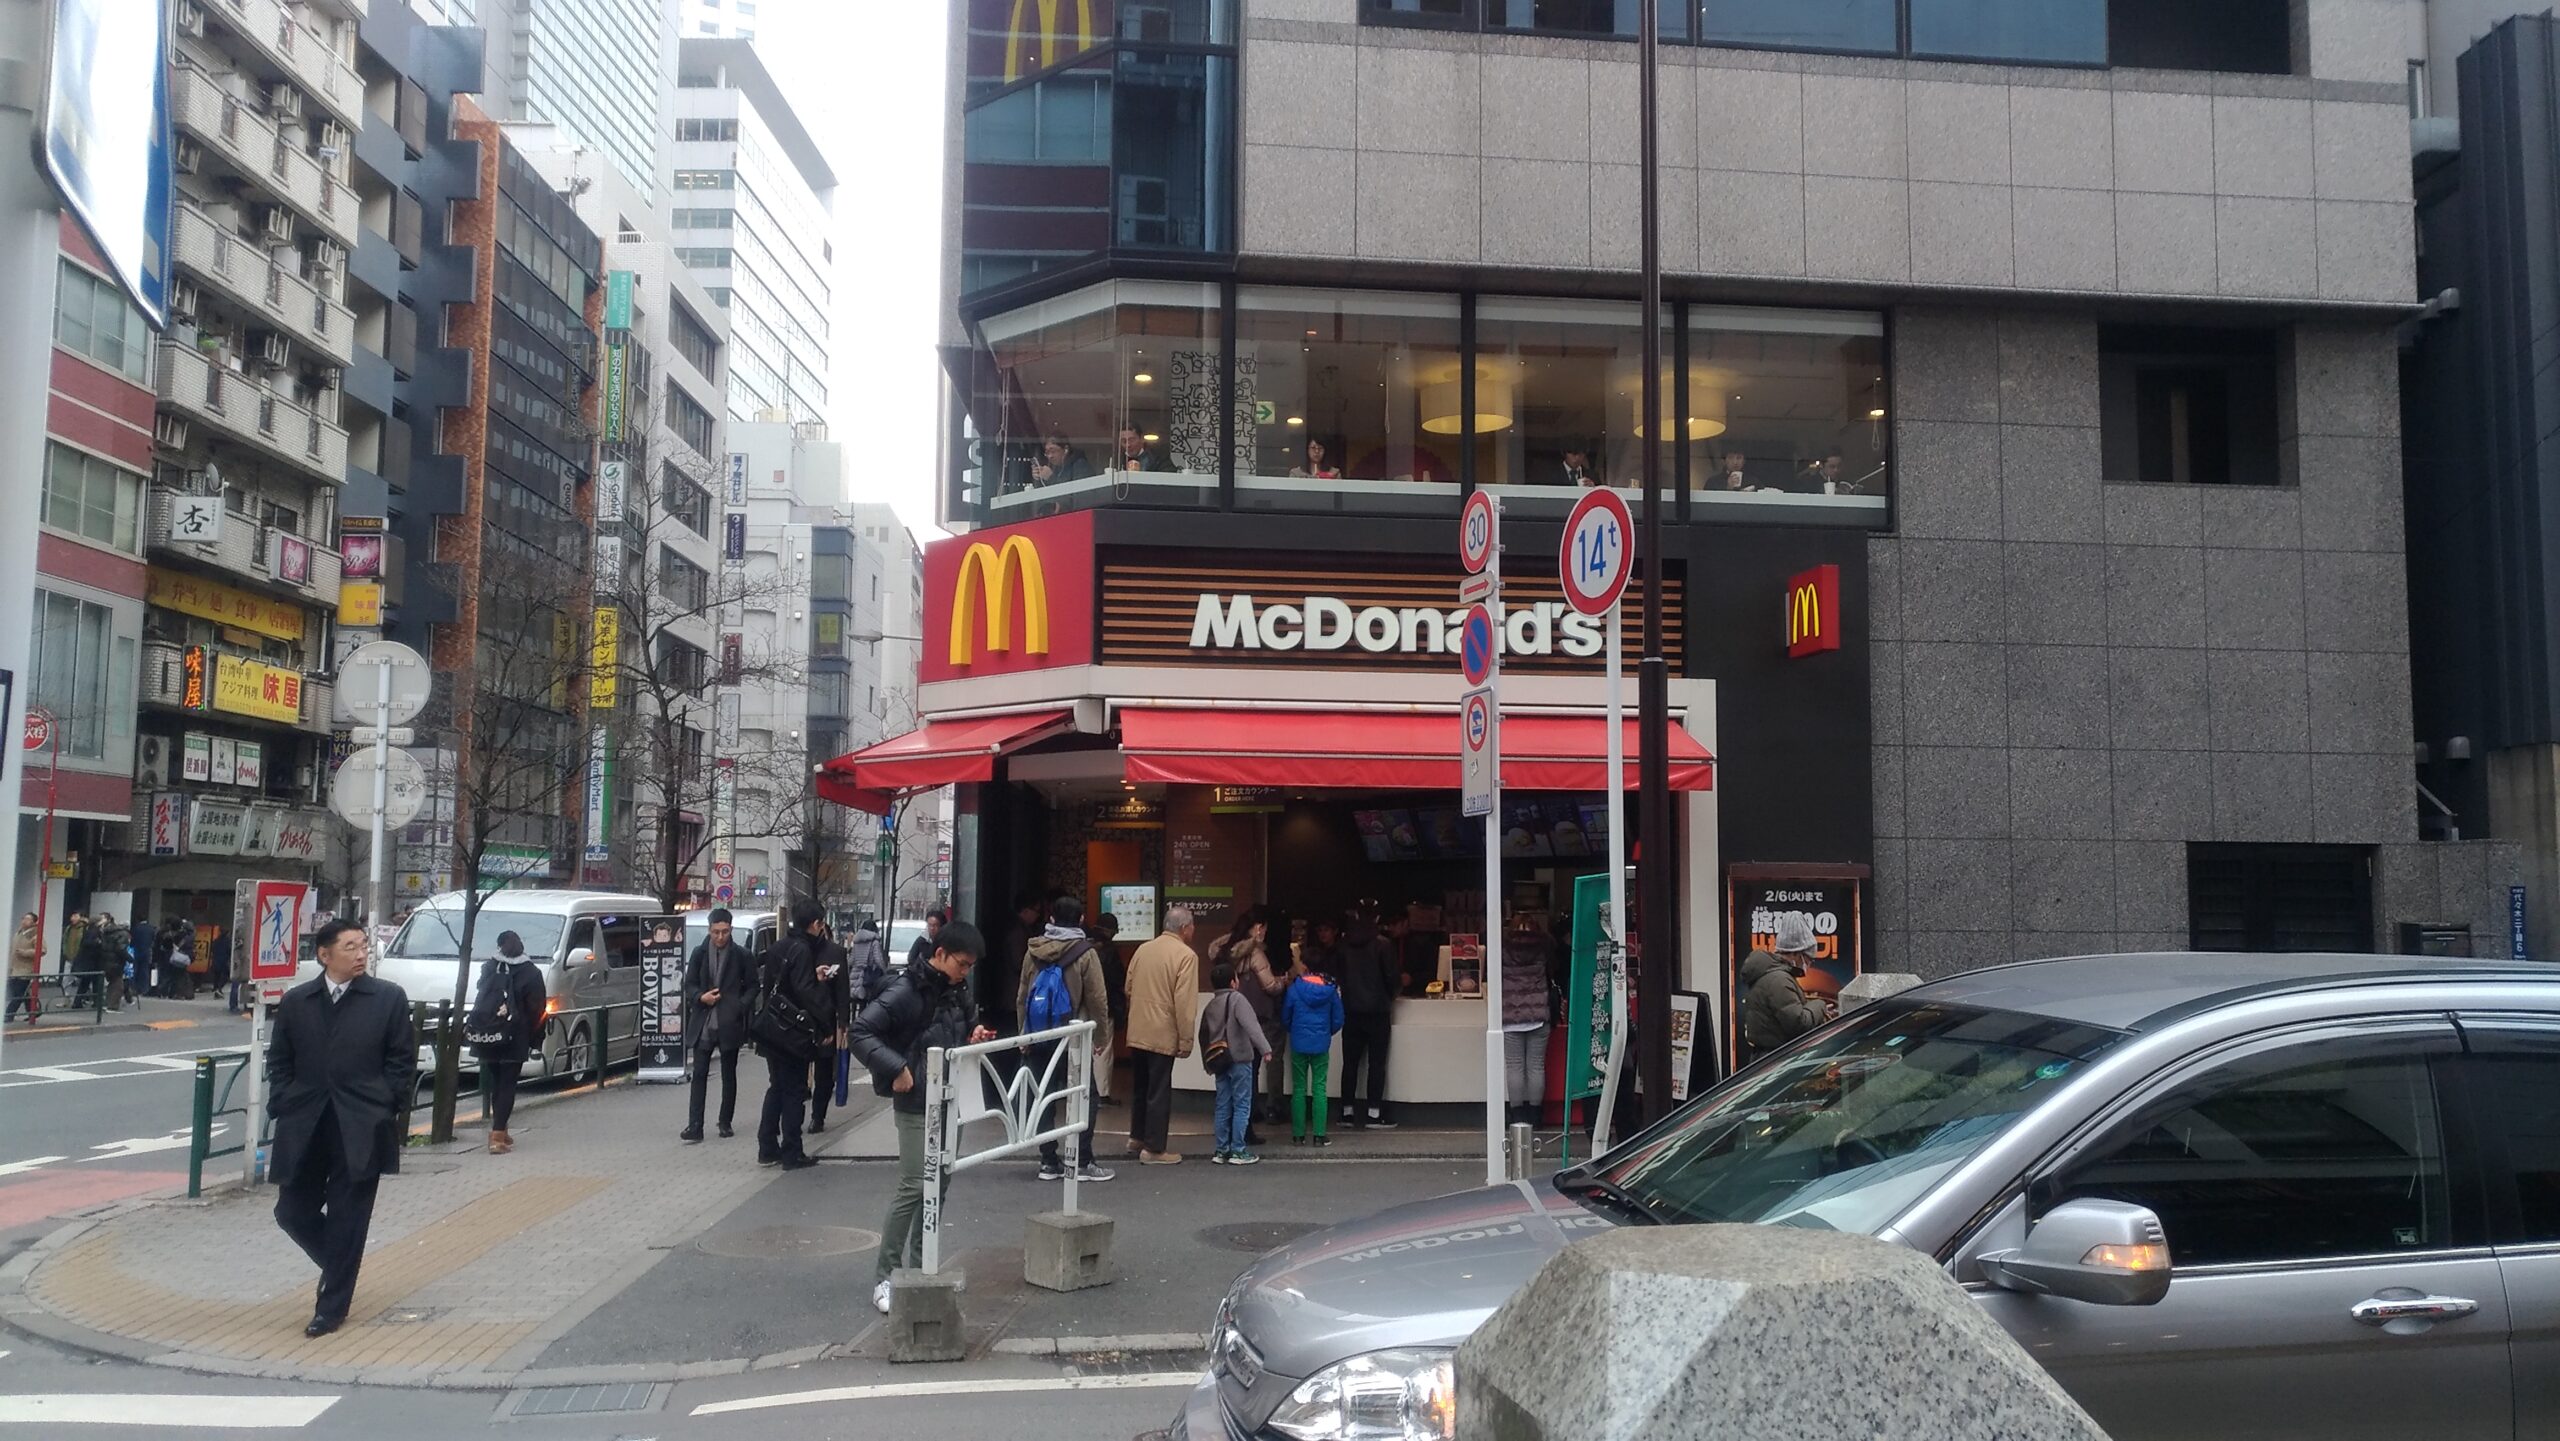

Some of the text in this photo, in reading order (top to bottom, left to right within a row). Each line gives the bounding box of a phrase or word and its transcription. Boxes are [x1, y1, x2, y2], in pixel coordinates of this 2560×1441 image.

[609, 349, 622, 438] 知の力を活かせる人に
[176, 504, 210, 535] 杏
[1468, 512, 1485, 551] 30
[1577, 520, 1617, 583] 14t
[184, 645, 202, 708] 味屋
[220, 661, 252, 681] 台湾中華
[221, 681, 259, 700] アジア料理
[263, 672, 299, 709] 味屋
[25, 724, 45, 739] 火栓
[186, 757, 207, 775] 居酒屋
[1213, 786, 1276, 802] 1 ご注文カウンター
[720, 826, 730, 852] VEOCE
[1190, 841, 1210, 849] OPEN
[1765, 890, 1824, 902] 2/6(火)まで
[642, 955, 659, 1034] BOWZU
[466, 1032, 503, 1043] adidas
